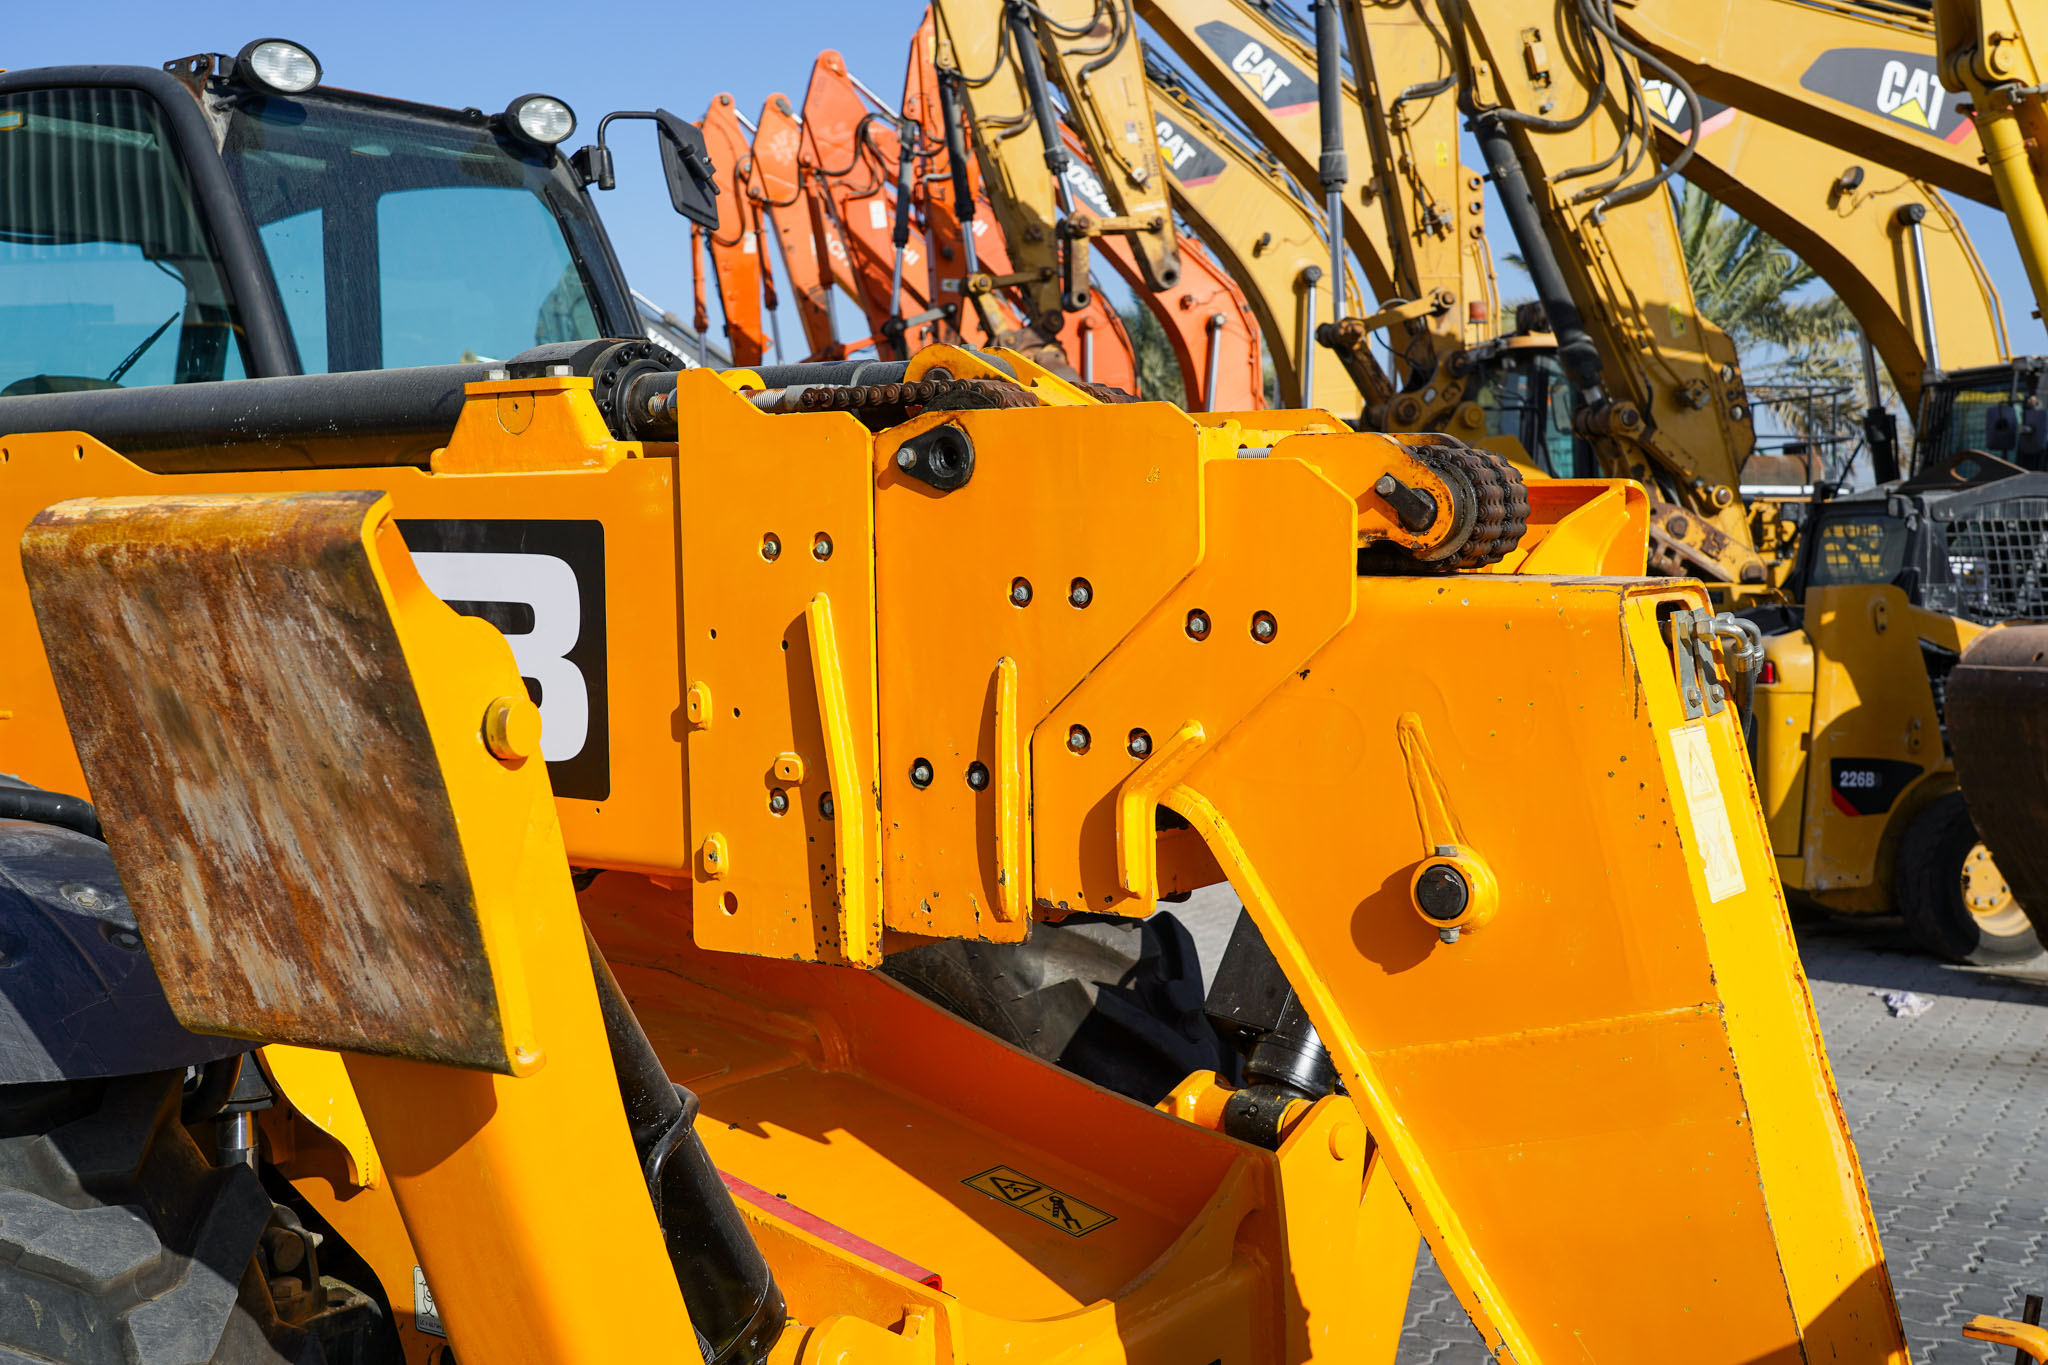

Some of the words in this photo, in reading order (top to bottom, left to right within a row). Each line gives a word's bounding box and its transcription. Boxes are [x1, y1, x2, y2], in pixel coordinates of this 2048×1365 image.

[1232, 42, 1292, 102] CAT
[1877, 60, 1946, 131] CAT
[1840, 770, 1875, 787] 226B
